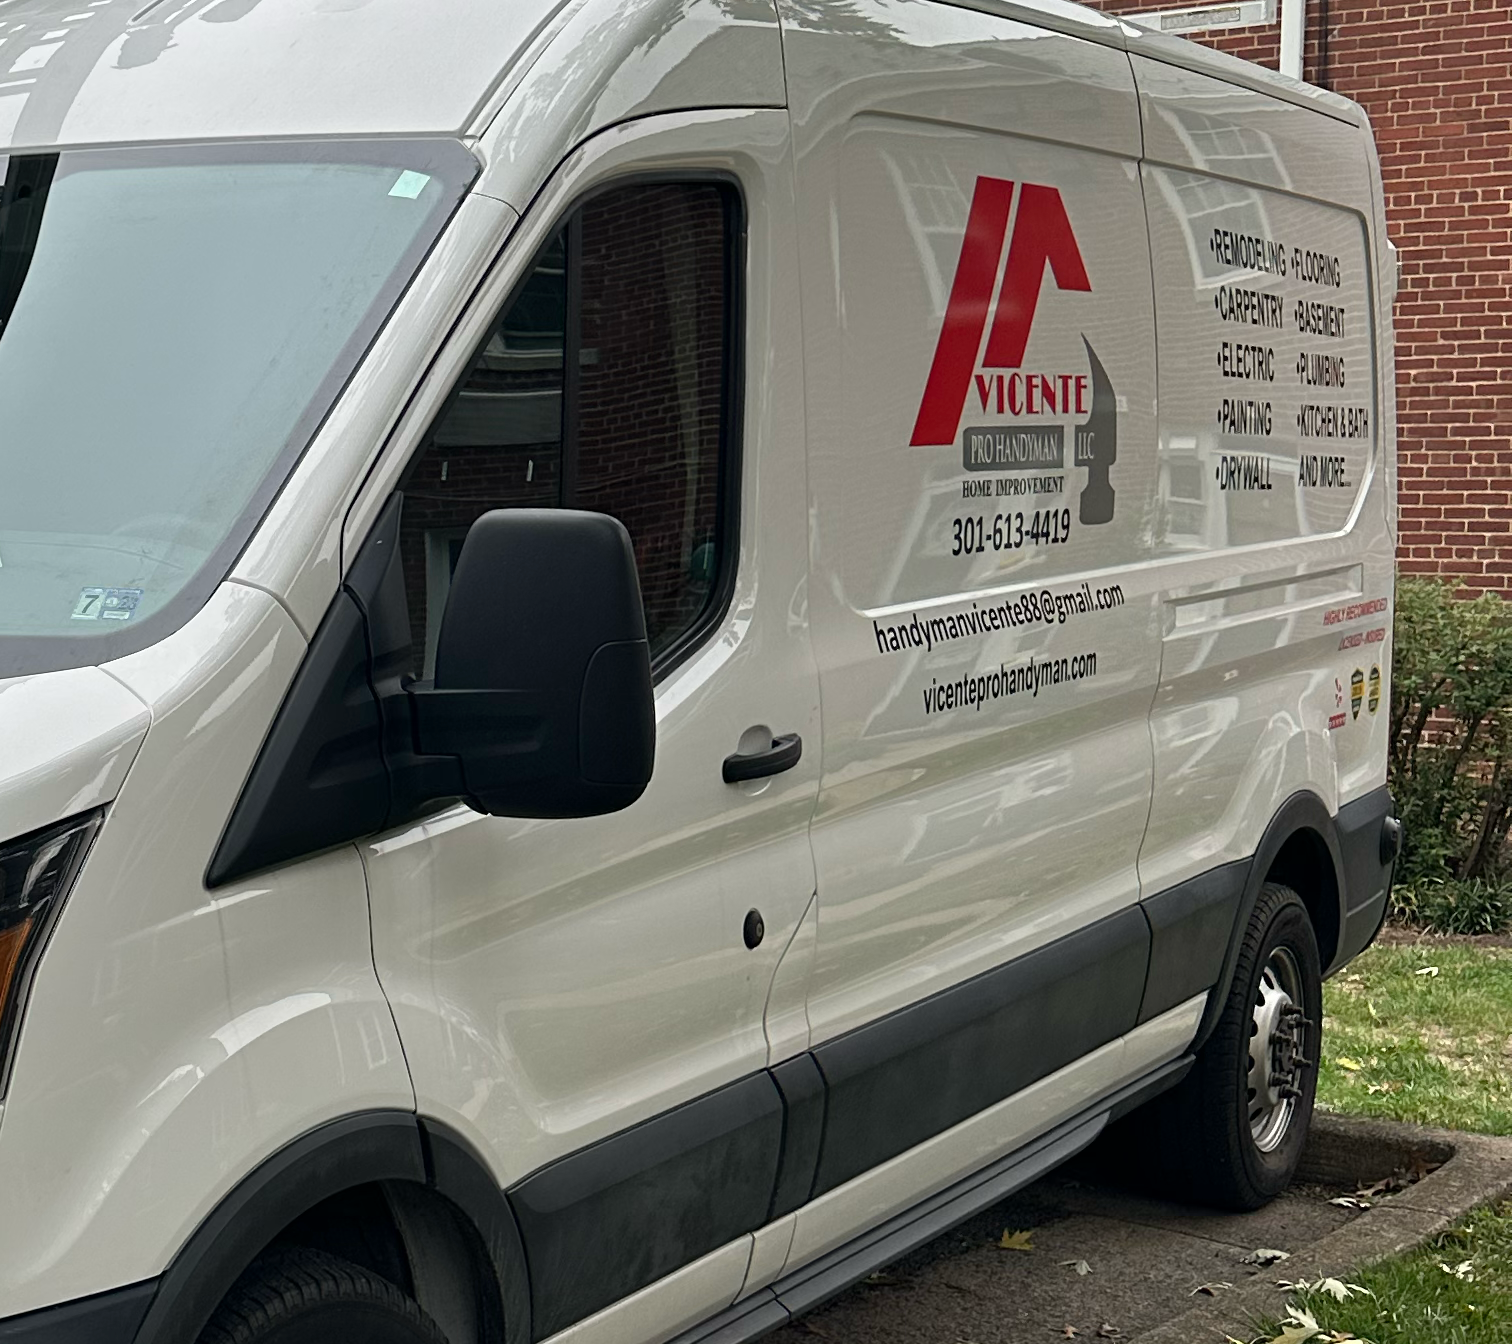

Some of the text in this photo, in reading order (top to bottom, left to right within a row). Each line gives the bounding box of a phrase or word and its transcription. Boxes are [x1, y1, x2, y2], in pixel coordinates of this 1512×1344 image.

[1213, 228, 1286, 277] REMODELING
[1294, 247, 1341, 288] FLOORING
[1219, 285, 1284, 329] CARPENTRY
[1297, 300, 1345, 338] BASEMENT
[1222, 341, 1275, 382] ELECTRIC
[1300, 352, 1345, 388] PLUMBING
[974, 372, 1088, 416] VICENTE
[1222, 399, 1272, 436] PAINTING
[1300, 404, 1369, 439] KITCHEN & BATH
[970, 432, 1058, 464] PRO HANDYMAN
[1077, 432, 1095, 460] LLC
[962, 476, 1065, 498] HOME IMPROVEMENT
[1220, 456, 1272, 490] DRYWALL
[1298, 455, 1318, 487] AND
[951, 508, 1072, 556] 301-613-4419
[82, 594, 100, 613] 7
[872, 582, 1126, 654] handymanvicente88@gmail.com
[923, 651, 1097, 715] vicenteprohandyman.com
